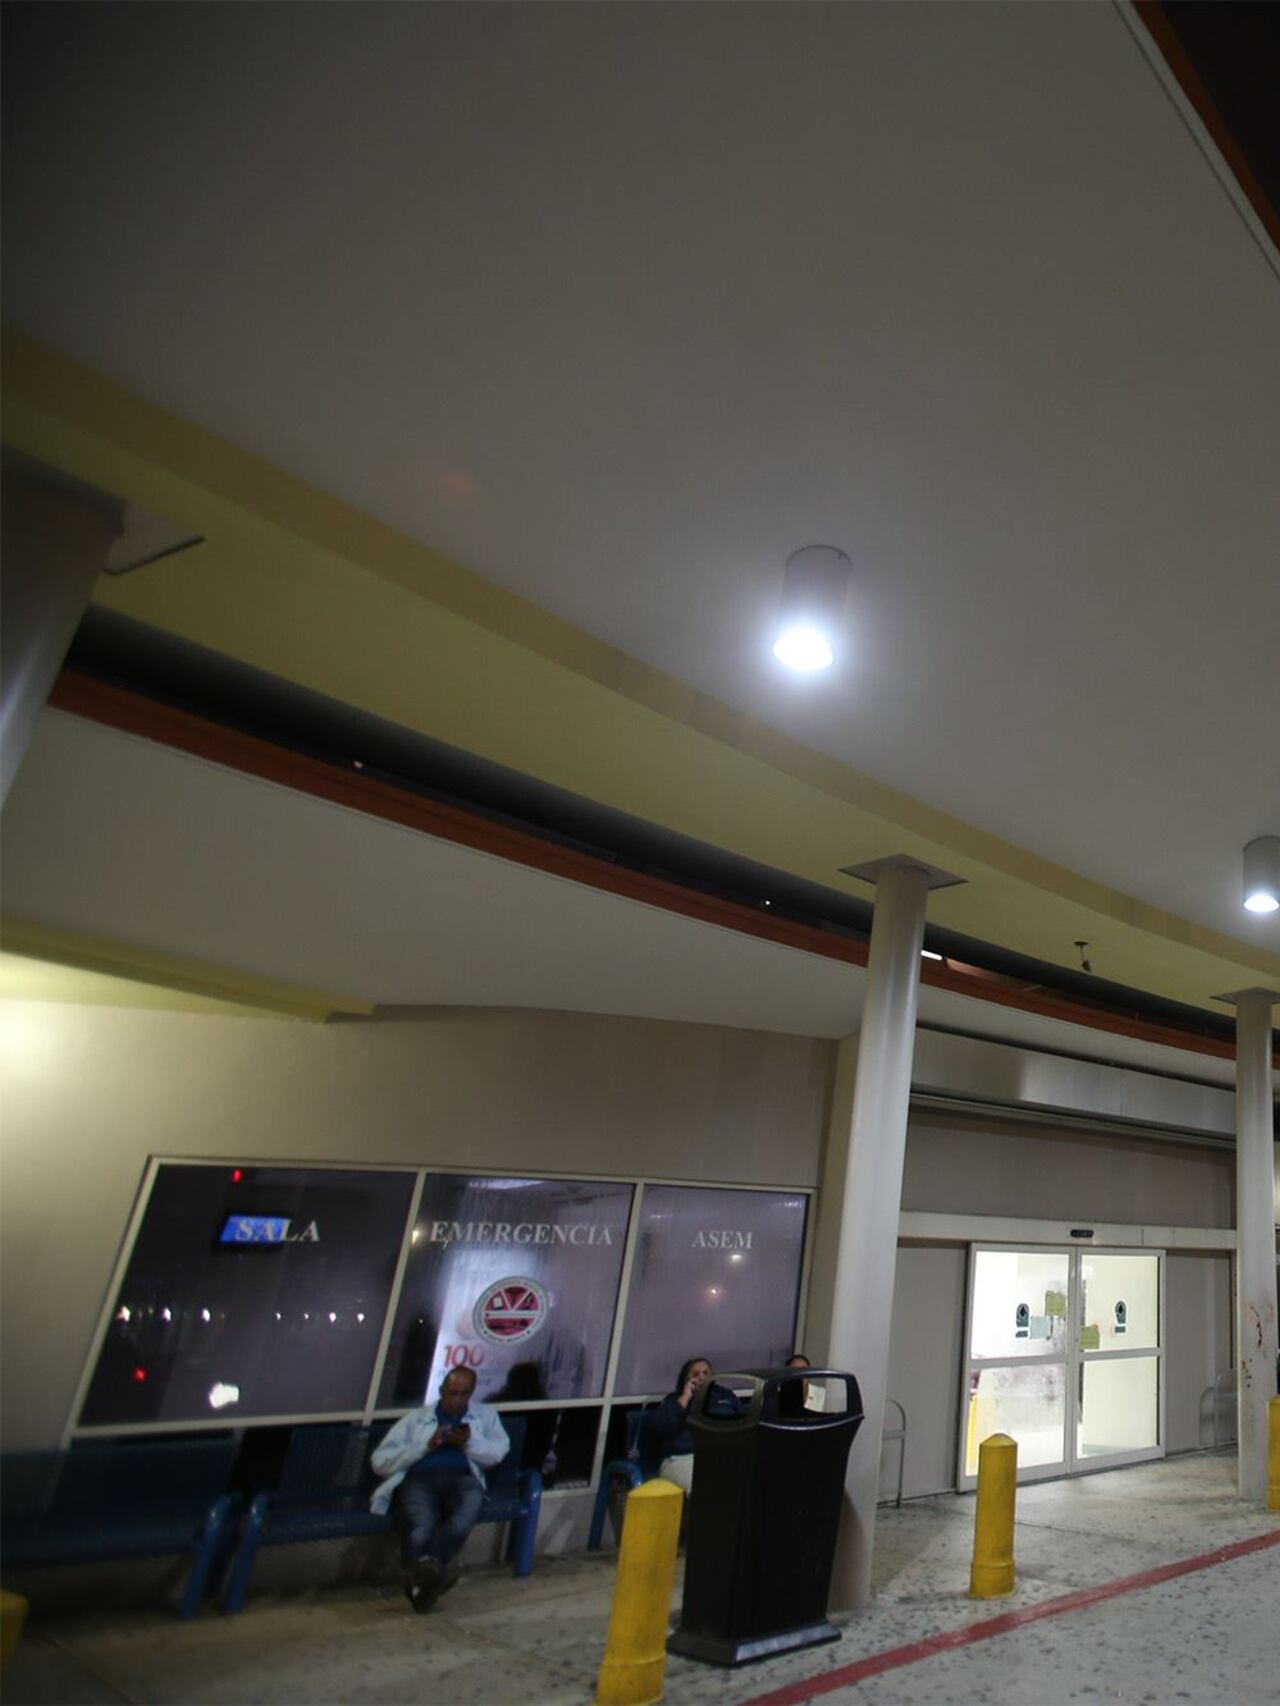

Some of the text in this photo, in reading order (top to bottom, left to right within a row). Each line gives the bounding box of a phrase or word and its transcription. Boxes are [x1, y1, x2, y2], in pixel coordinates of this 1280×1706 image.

[235, 1218, 753, 1249] SALA EMERGENCIA ASEM
